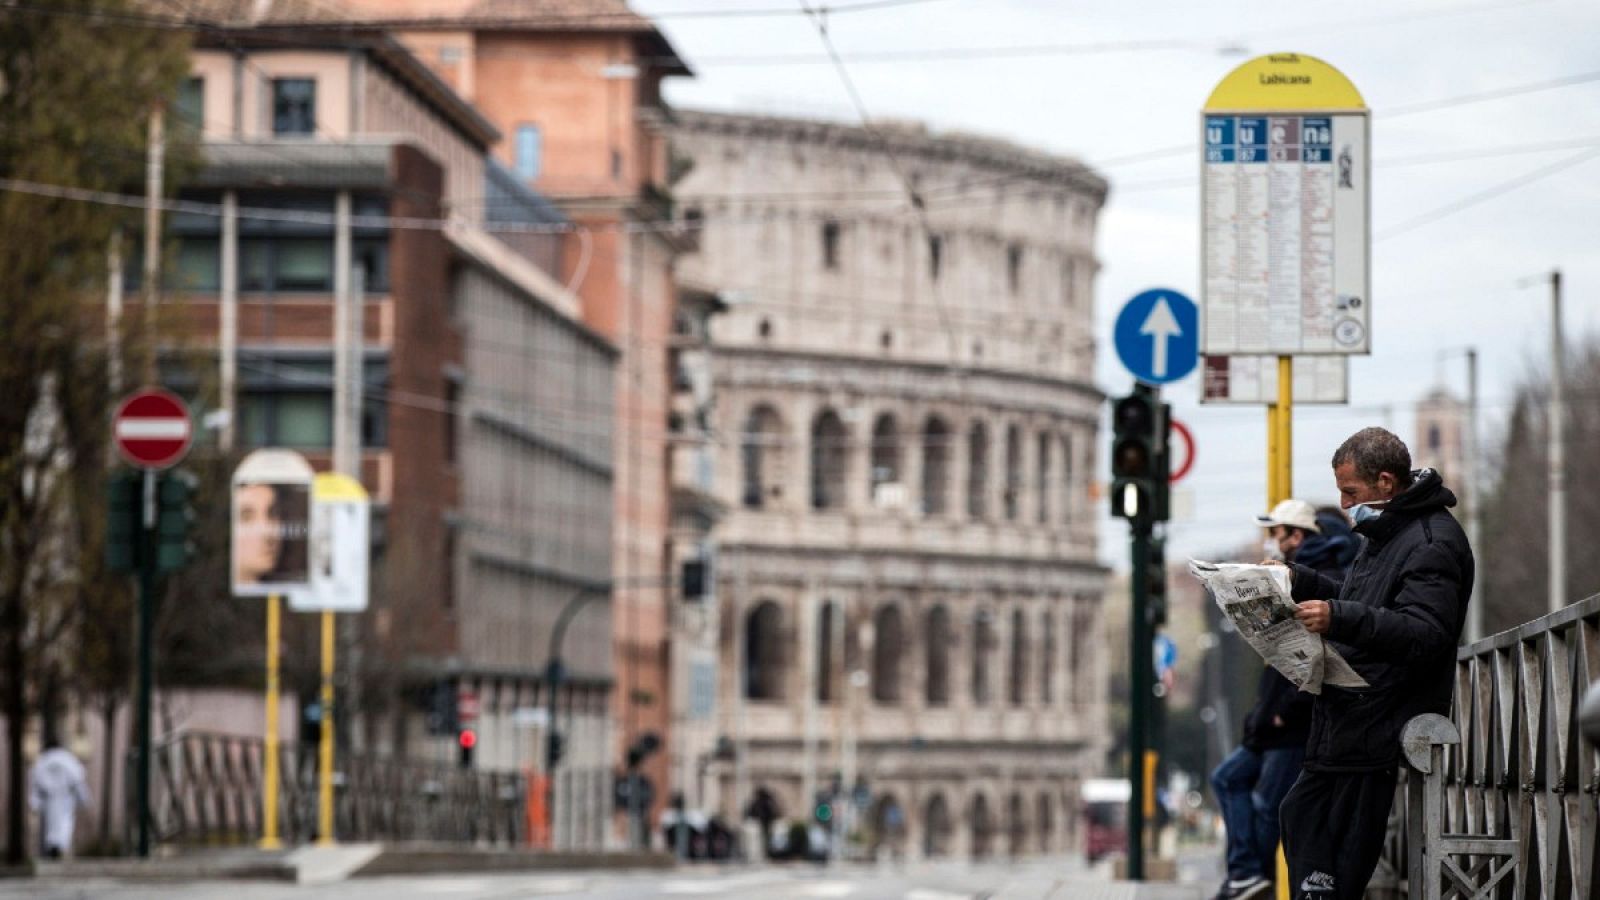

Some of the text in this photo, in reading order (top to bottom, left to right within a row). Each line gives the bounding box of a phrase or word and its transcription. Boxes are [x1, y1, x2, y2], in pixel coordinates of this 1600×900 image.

[1259, 73, 1312, 85] Labicana
[1207, 127, 1222, 144] u
[1240, 127, 1255, 144] u
[1272, 126, 1286, 144] e
